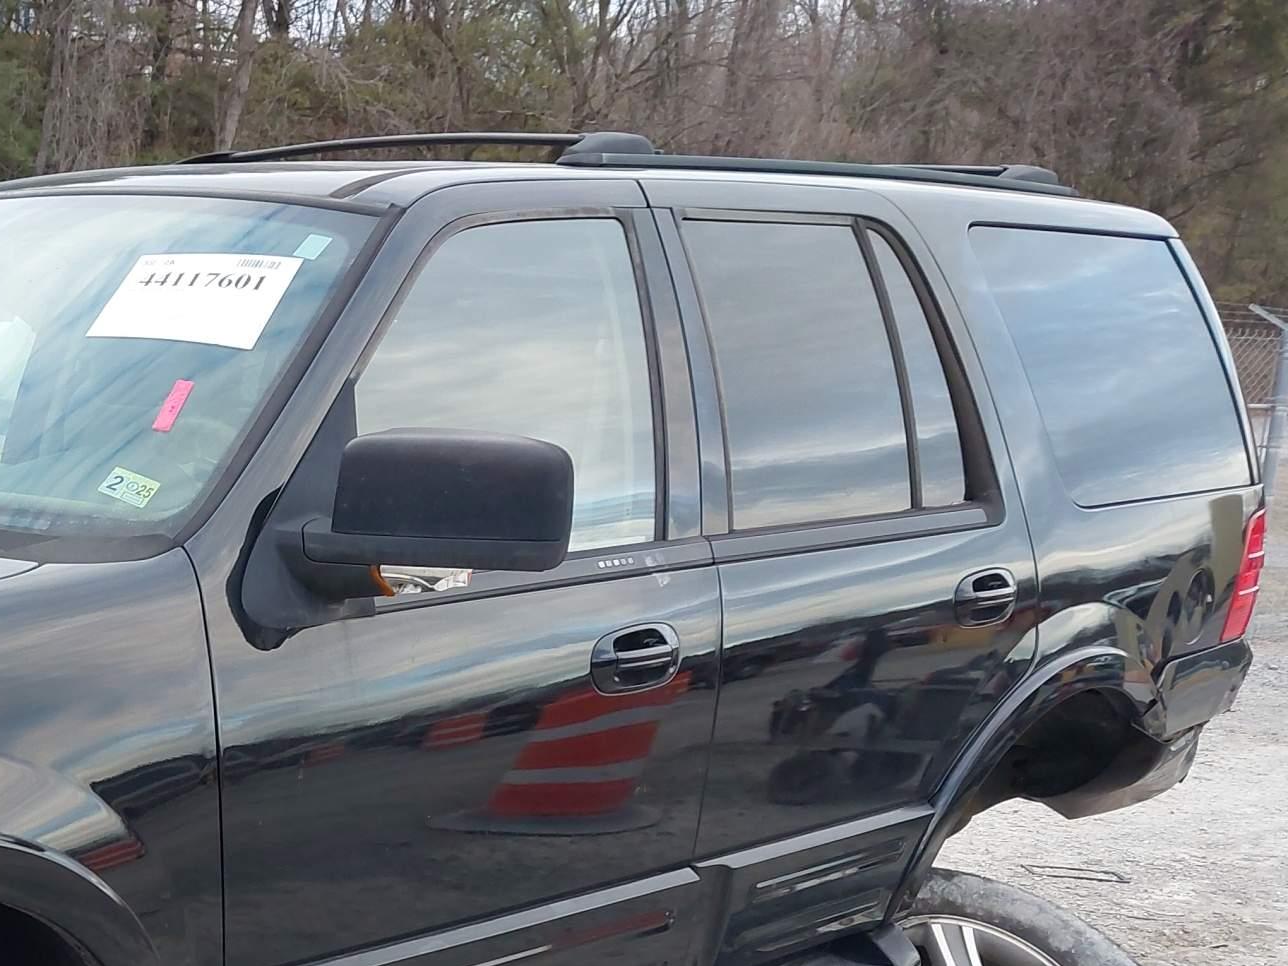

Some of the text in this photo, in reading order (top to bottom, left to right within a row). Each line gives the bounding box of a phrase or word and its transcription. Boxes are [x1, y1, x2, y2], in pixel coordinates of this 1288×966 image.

[137, 272, 267, 291] 44117601
[106, 475, 155, 499] 2 25
